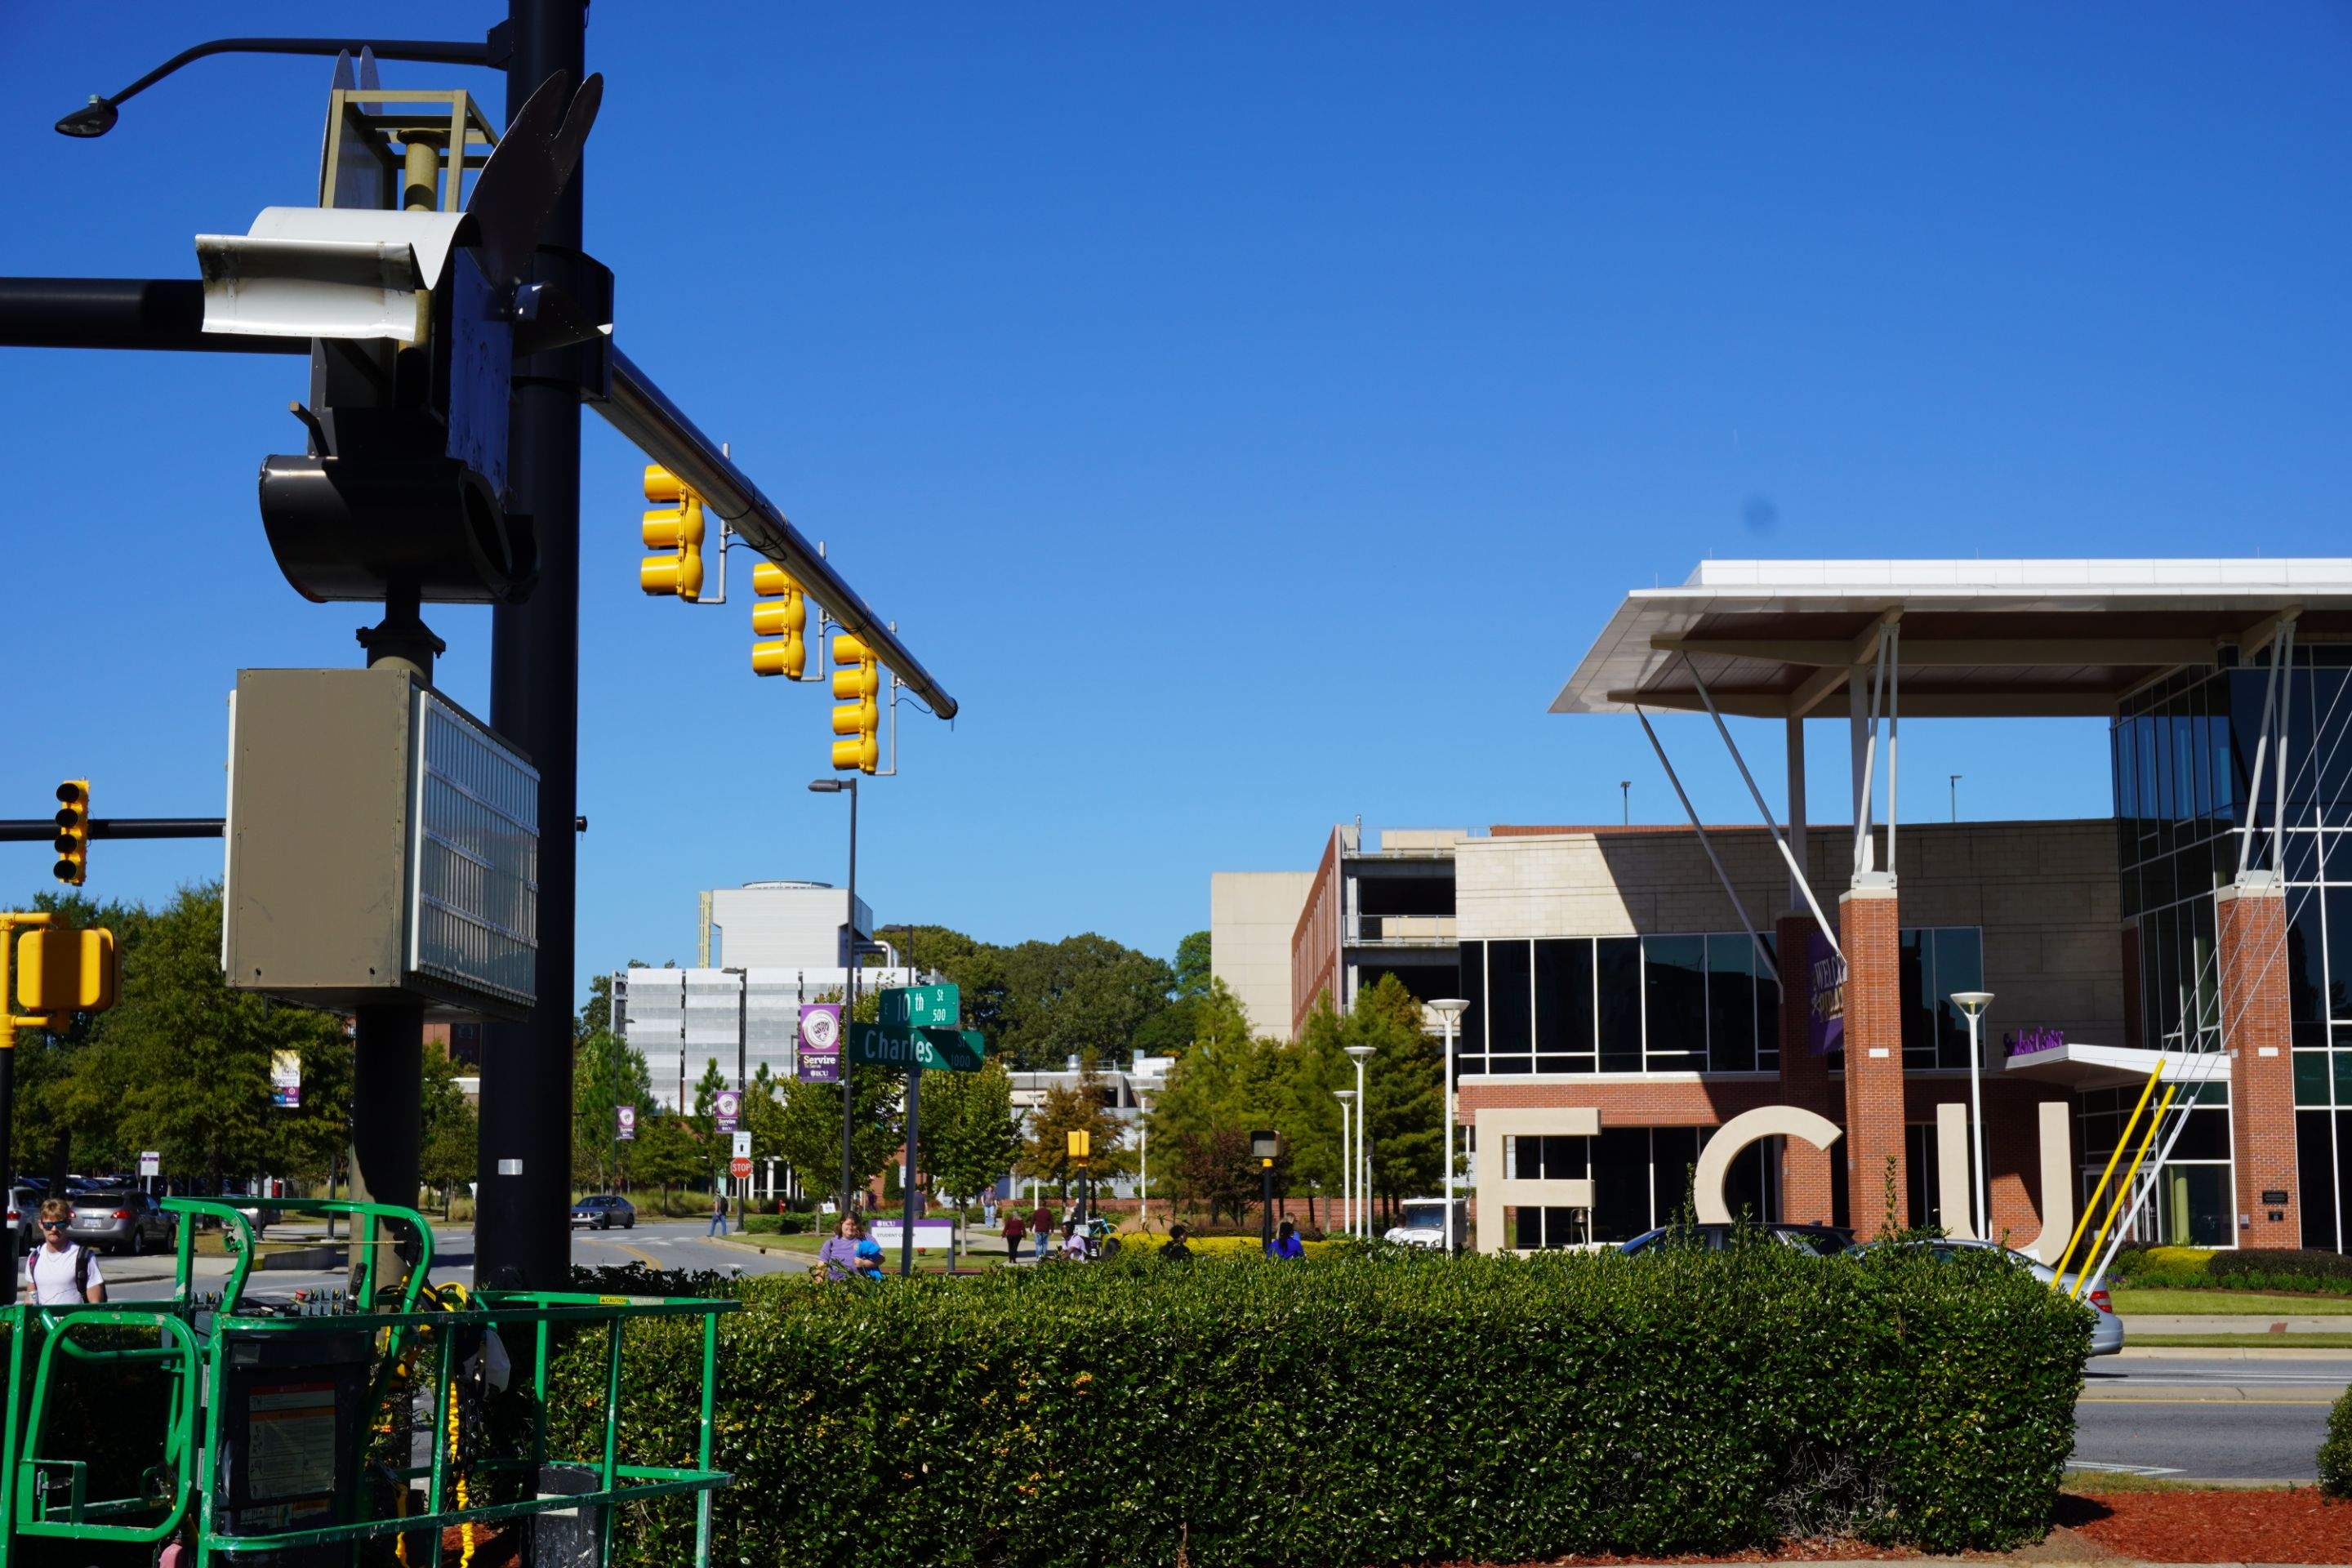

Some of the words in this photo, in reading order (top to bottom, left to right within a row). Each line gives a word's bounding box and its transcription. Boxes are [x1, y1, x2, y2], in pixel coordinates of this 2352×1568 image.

[937, 989, 944, 1002] St
[933, 1009, 947, 1022] 500
[865, 1029, 933, 1063] Charles
[804, 1055, 836, 1065] Servire
[732, 1163, 751, 1173] STOP
[1475, 1102, 2073, 1267] ECU
[605, 1295, 628, 1303] CAUTION
